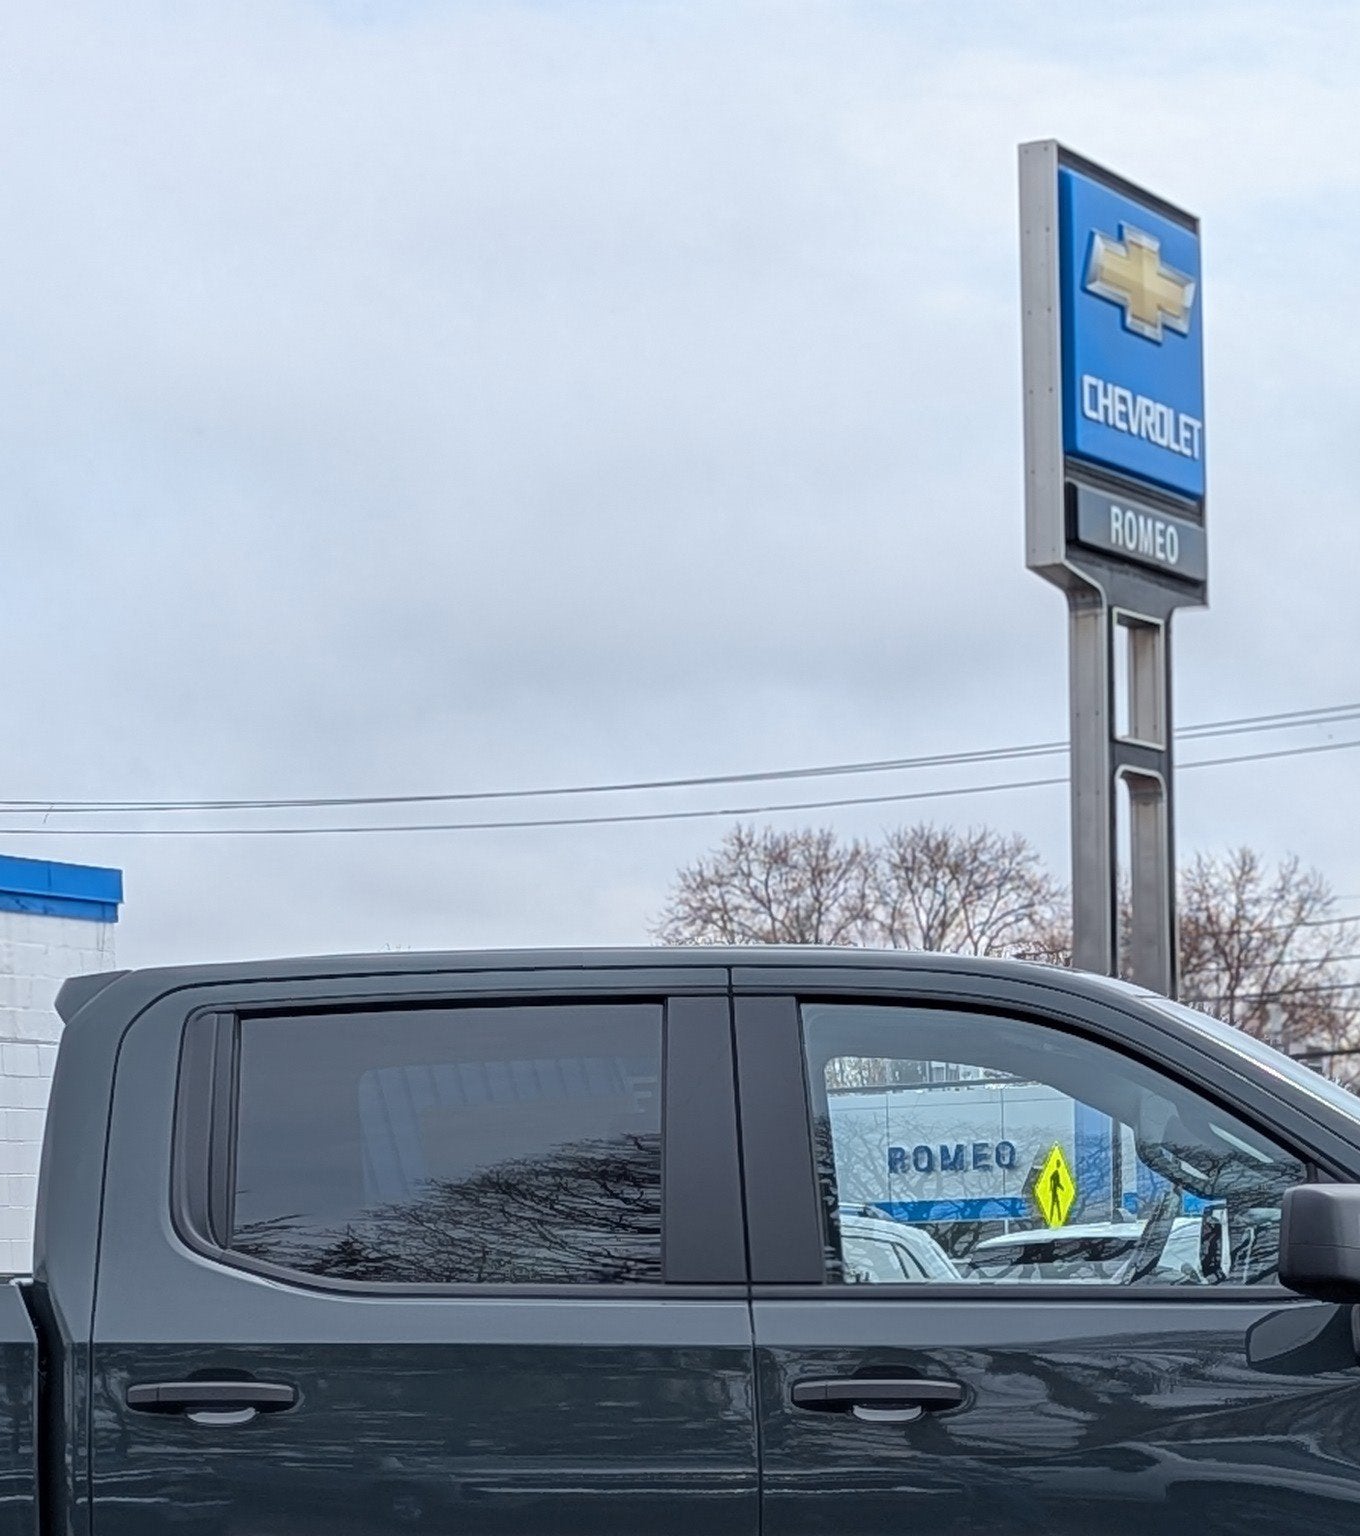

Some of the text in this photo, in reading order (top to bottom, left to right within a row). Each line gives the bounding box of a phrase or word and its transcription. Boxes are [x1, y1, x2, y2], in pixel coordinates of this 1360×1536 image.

[1081, 374, 1202, 460] CHEVROLET
[1110, 505, 1179, 566] ROMEO
[888, 1140, 1017, 1174] ROMEO
